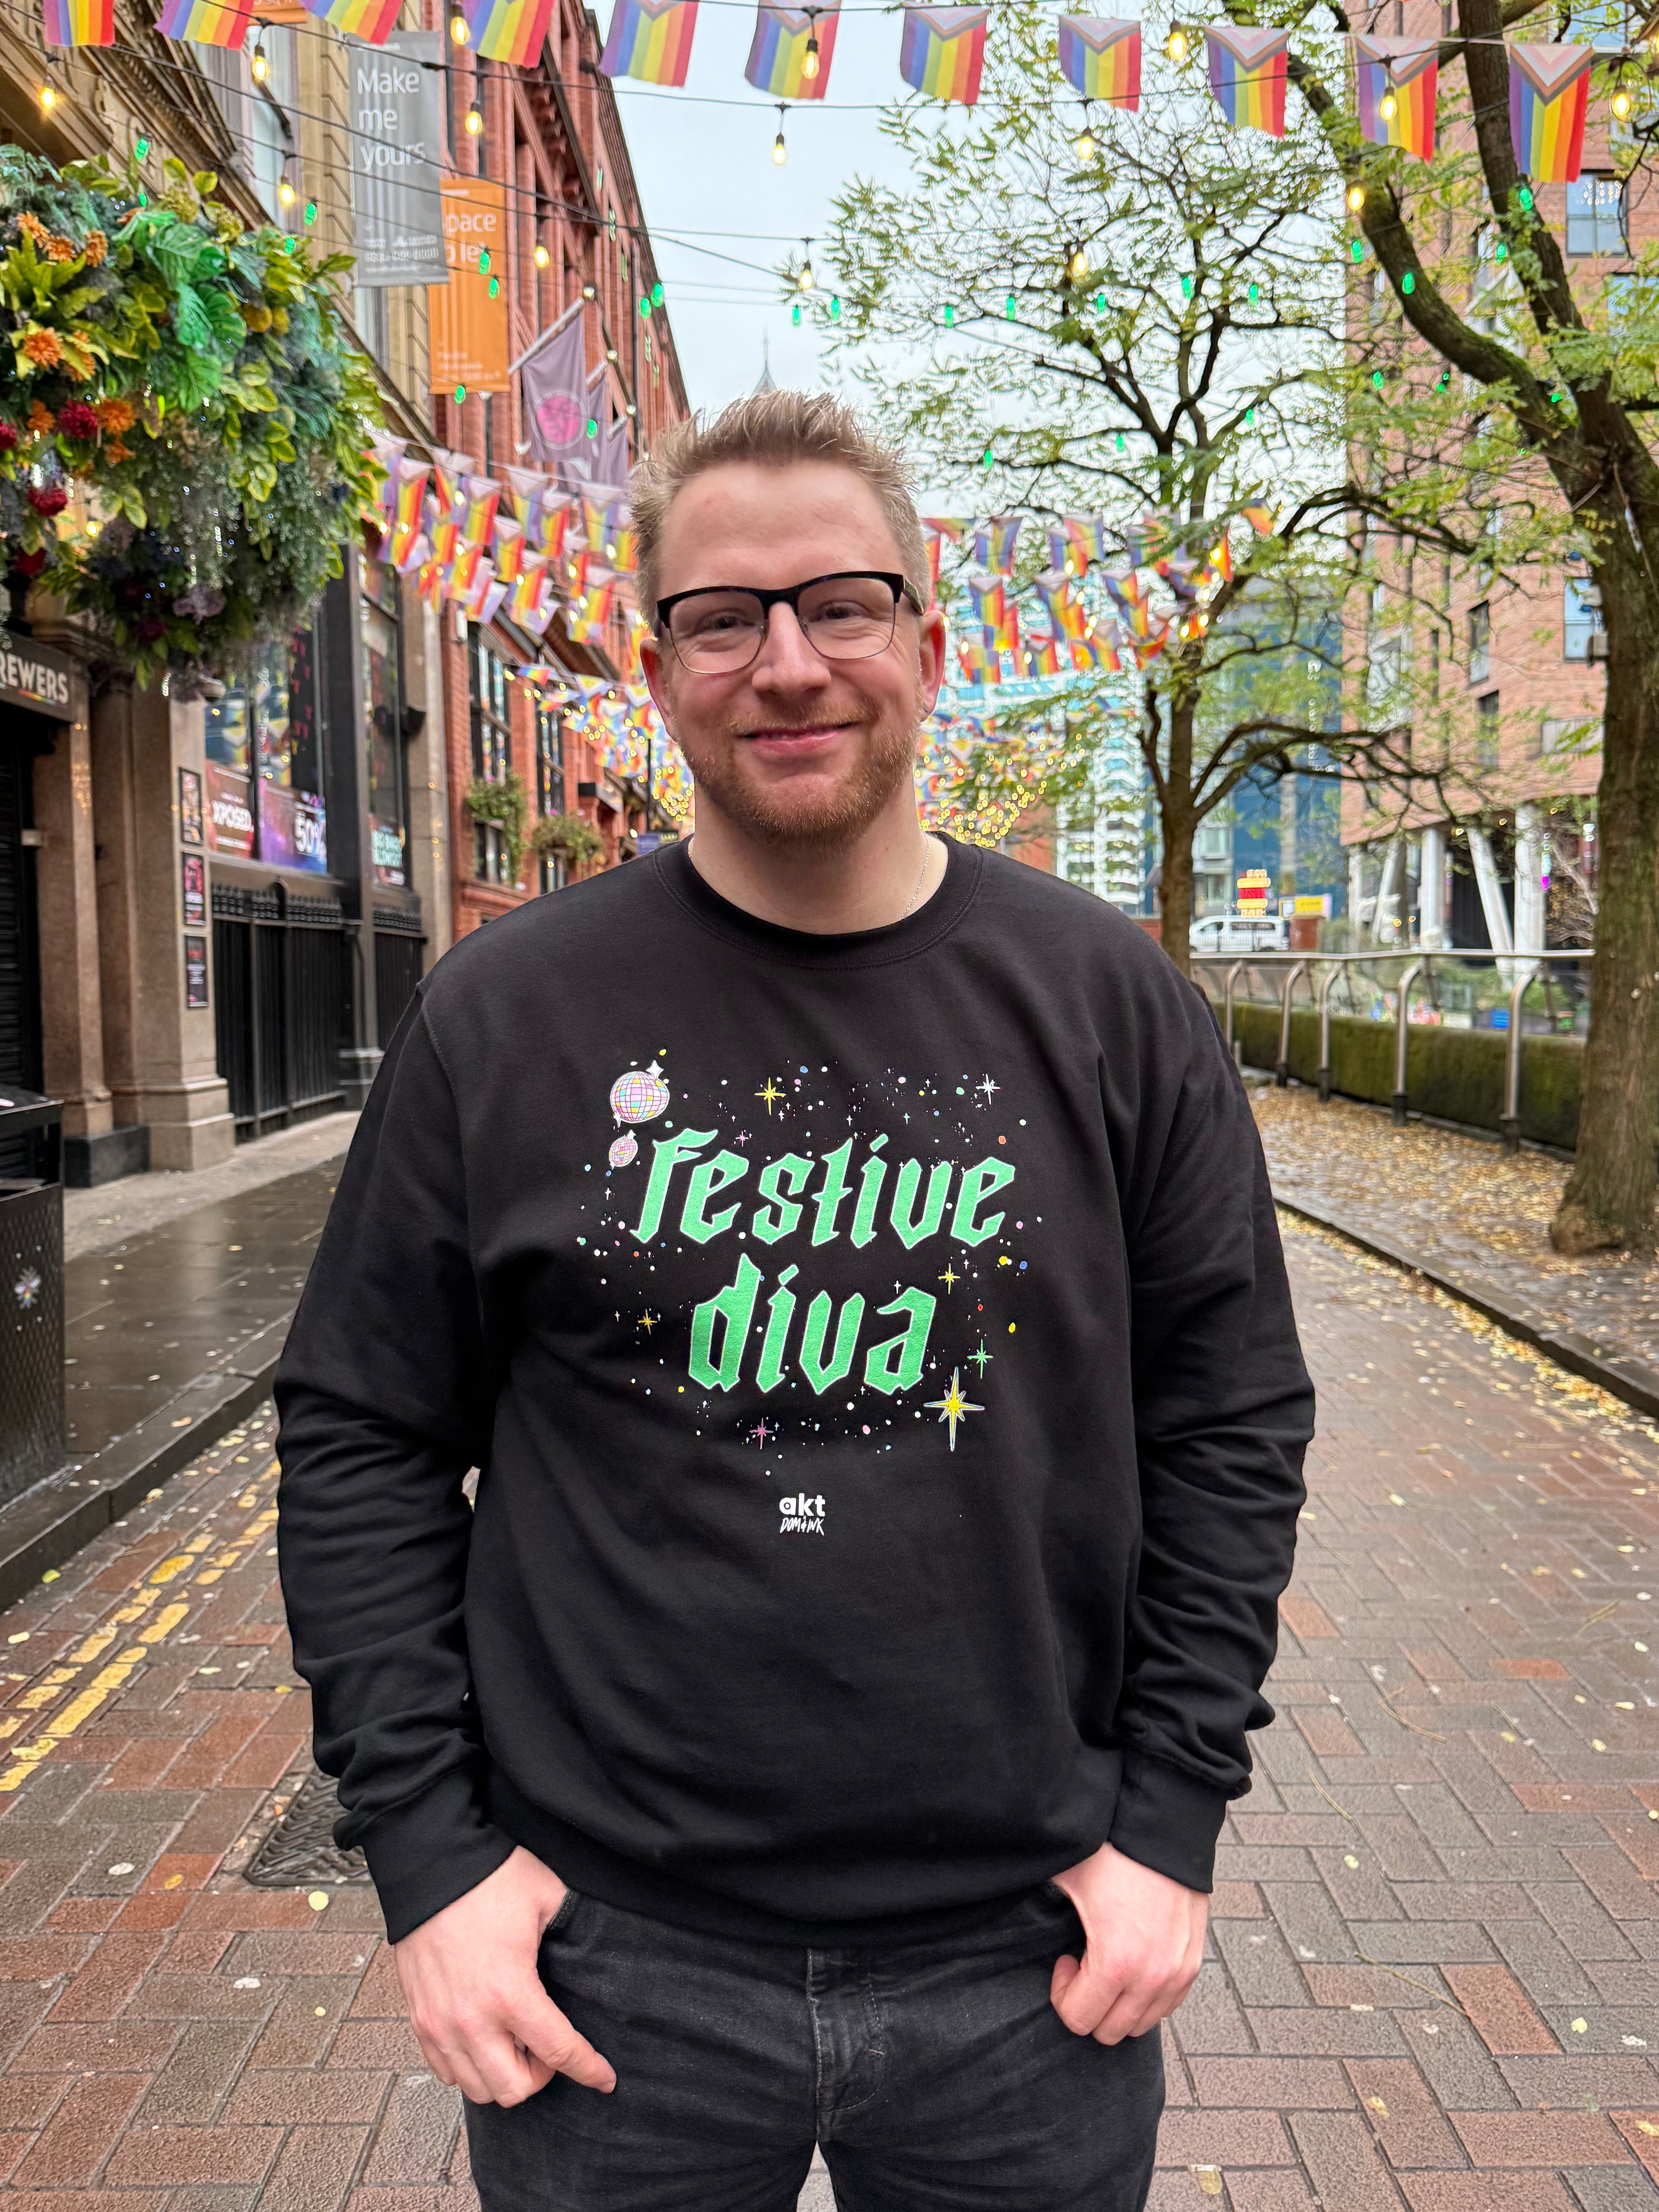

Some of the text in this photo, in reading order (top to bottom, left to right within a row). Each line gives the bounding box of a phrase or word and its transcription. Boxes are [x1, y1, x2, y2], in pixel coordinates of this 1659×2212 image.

[357, 66, 420, 94] Make
[358, 108, 398, 130] me
[359, 141, 427, 170] yours
[445, 213, 496, 236] pace
[460, 239, 485, 263] le
[689, 1253, 937, 1395] diva
[779, 1493, 826, 1517] akt
